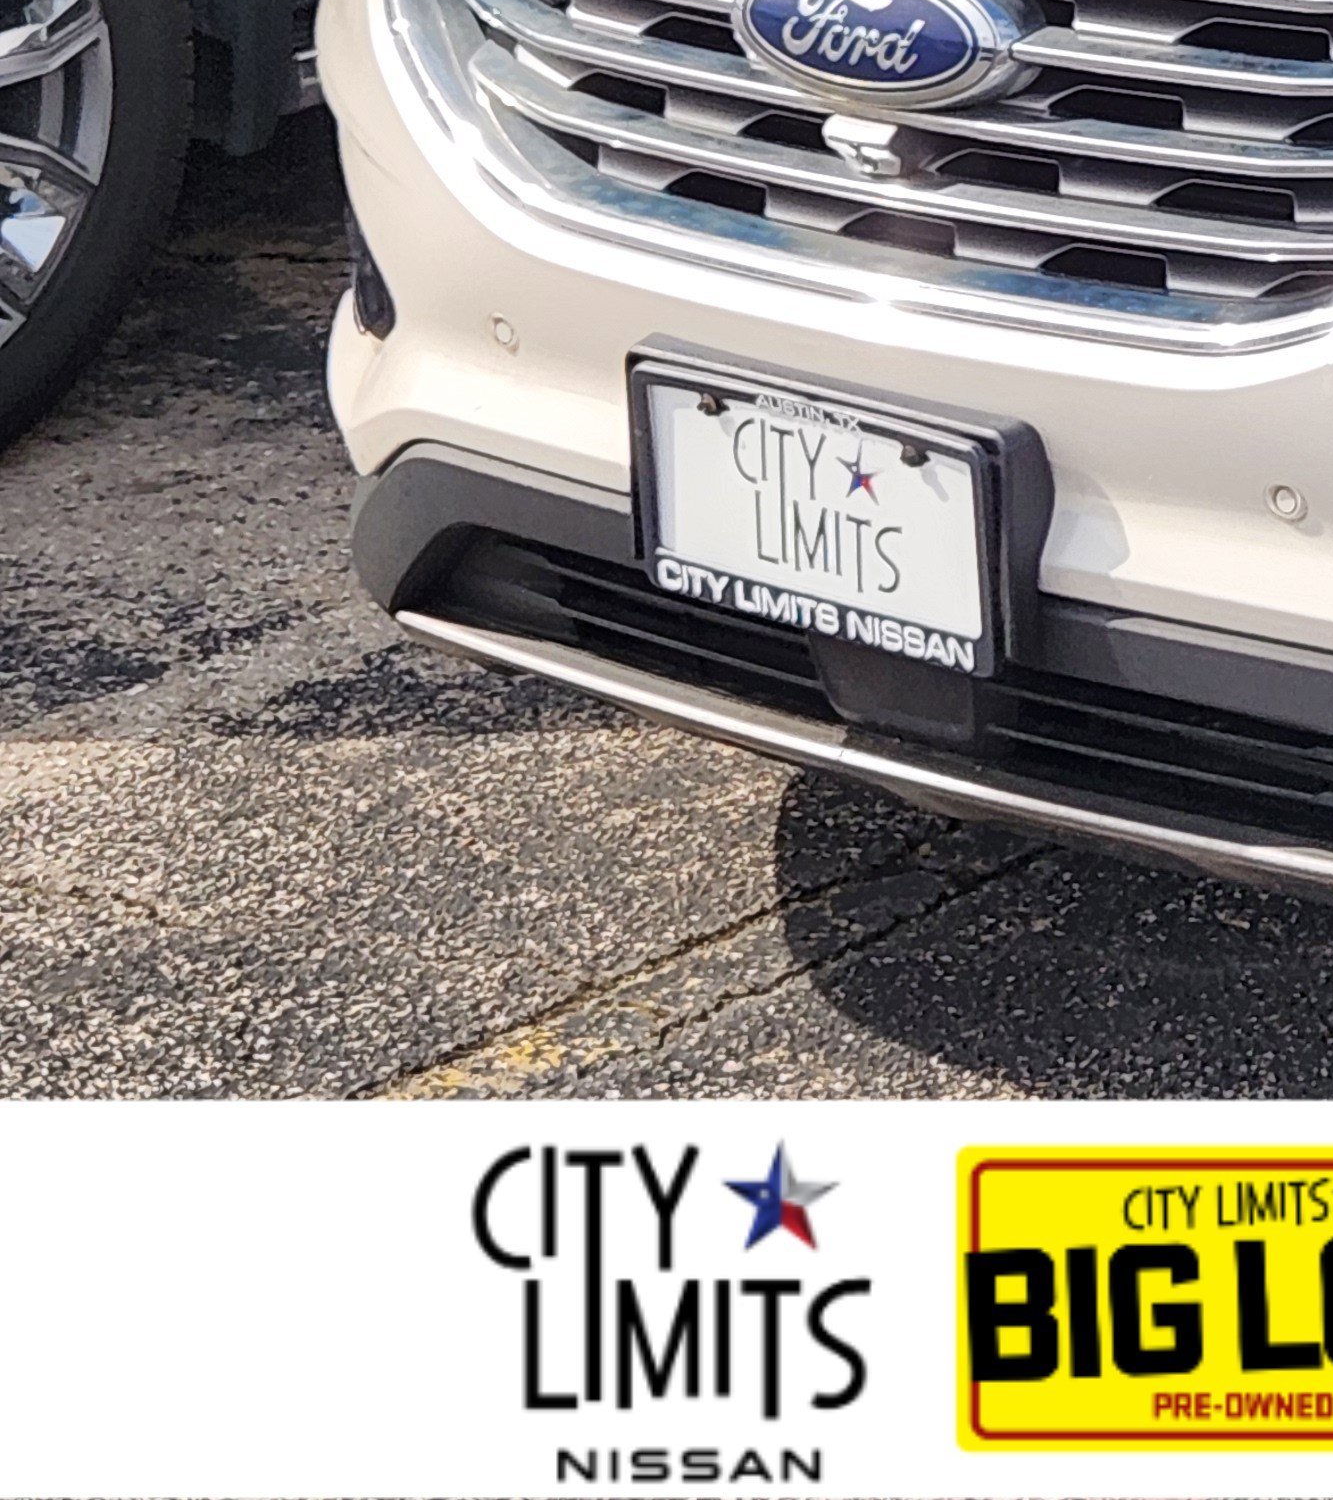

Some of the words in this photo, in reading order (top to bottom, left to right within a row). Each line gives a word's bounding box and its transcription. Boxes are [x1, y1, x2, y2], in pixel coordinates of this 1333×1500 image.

[733, 418, 827, 508] CITY
[754, 489, 902, 593] LIMITS
[657, 558, 729, 602] CITY
[734, 580, 839, 635] LIMITS
[846, 610, 975, 673] NISSAN
